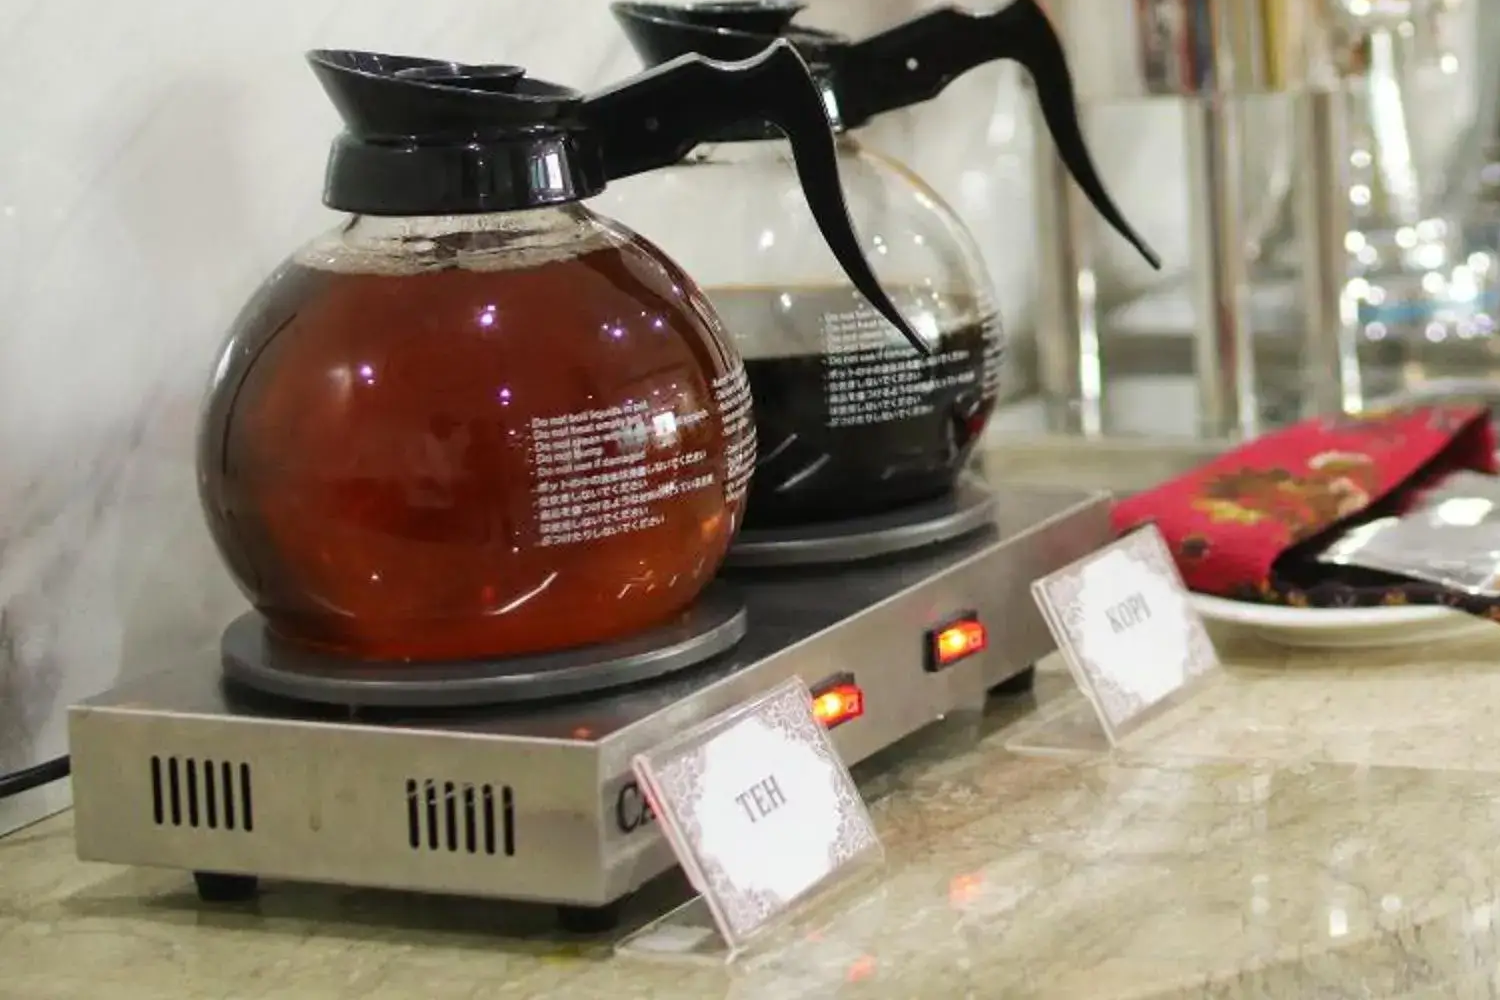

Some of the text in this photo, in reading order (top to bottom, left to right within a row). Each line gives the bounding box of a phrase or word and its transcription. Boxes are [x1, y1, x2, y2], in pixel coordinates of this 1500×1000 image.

[532, 417, 548, 429] Do
[550, 416, 567, 425] not
[534, 429, 549, 440] Do
[552, 428, 568, 437] not
[1105, 592, 1152, 634] KOPI
[735, 775, 787, 823] TEH
